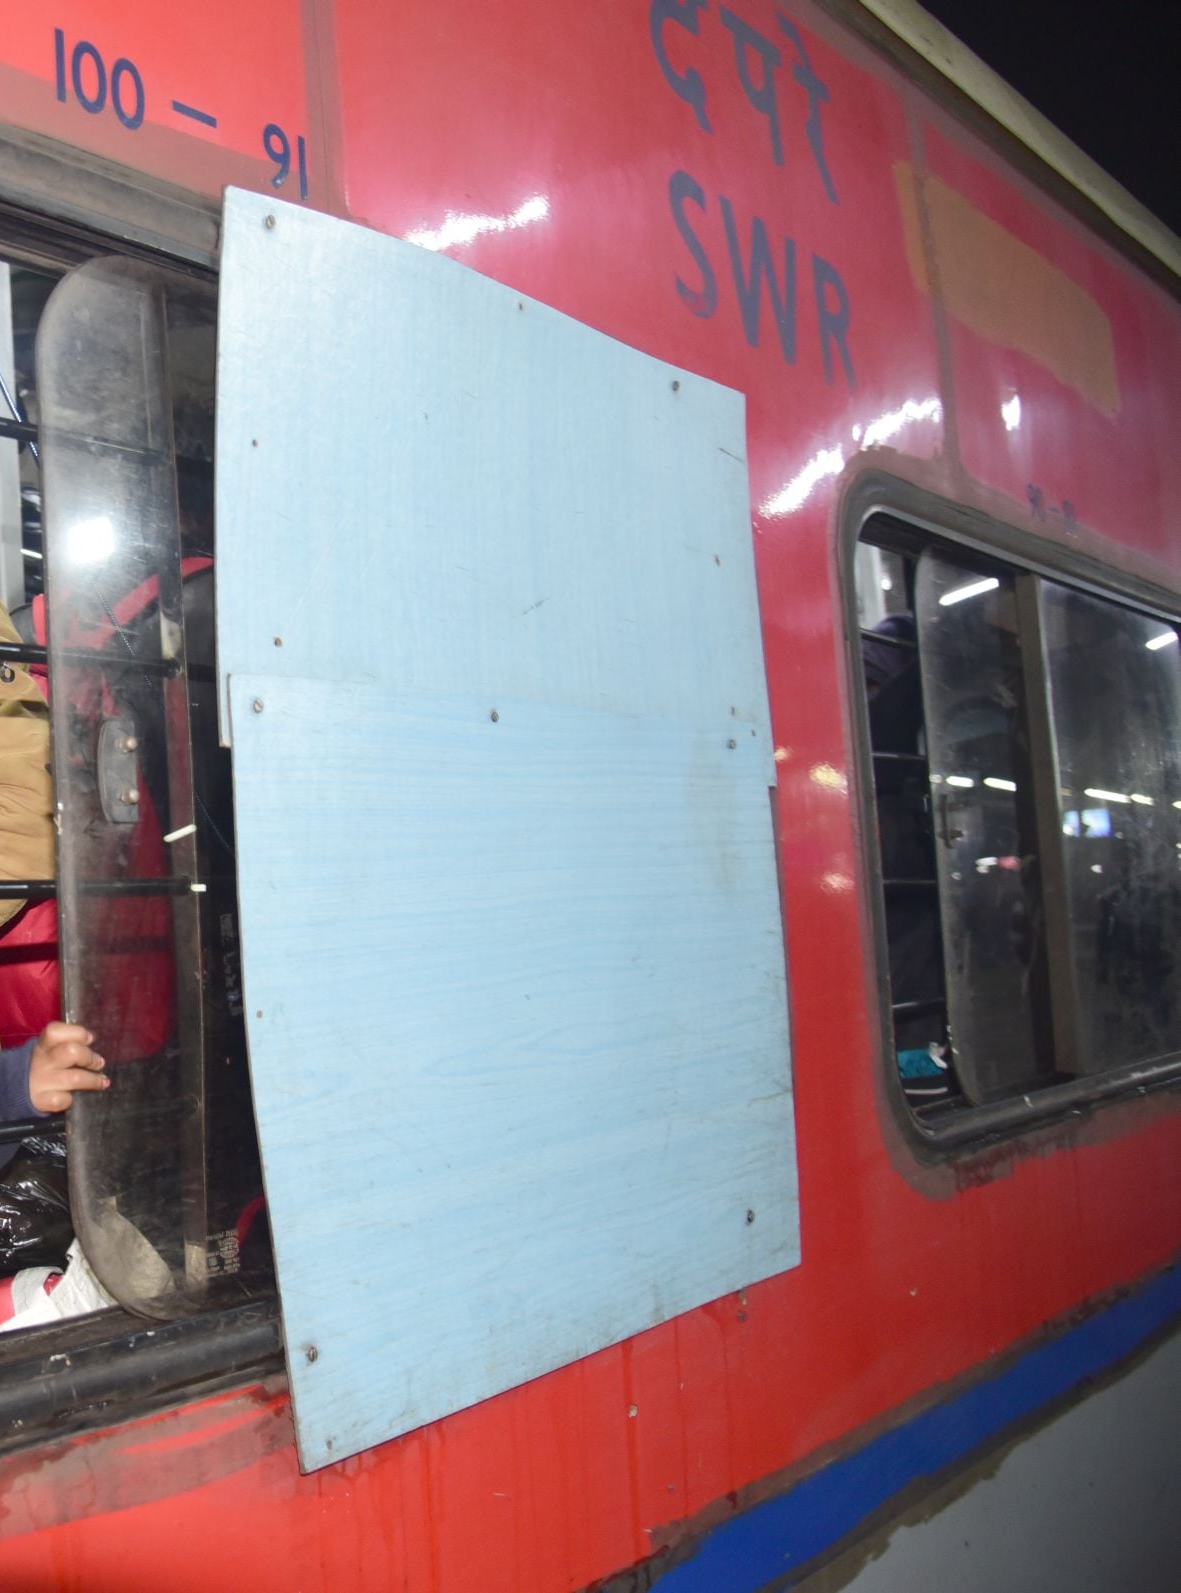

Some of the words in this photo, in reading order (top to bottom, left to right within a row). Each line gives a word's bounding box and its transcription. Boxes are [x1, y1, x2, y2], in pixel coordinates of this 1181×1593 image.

[54, 27, 145, 130] 100
[262, 123, 308, 200] 91
[668, 169, 857, 390] SWR
